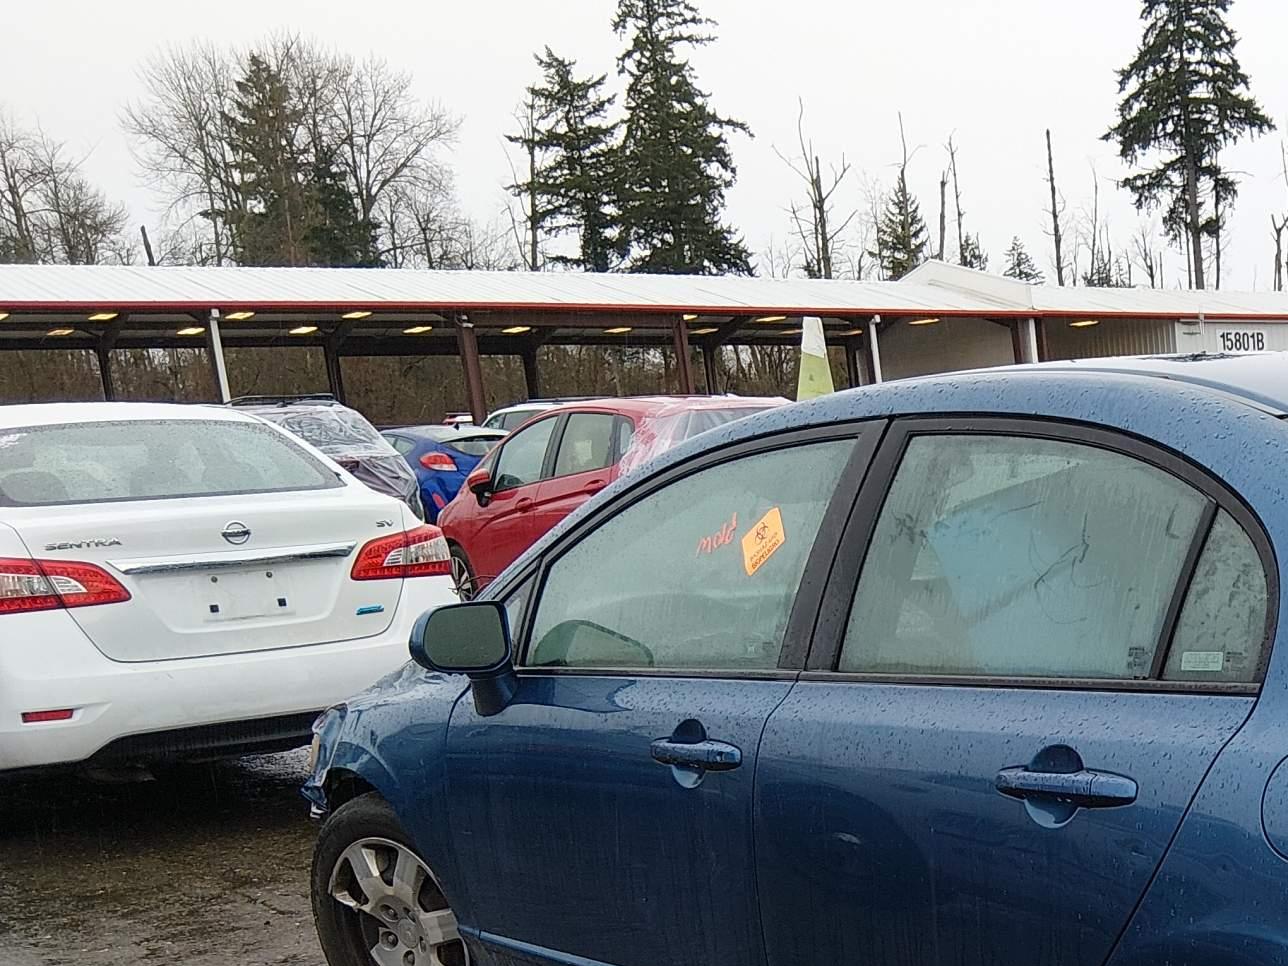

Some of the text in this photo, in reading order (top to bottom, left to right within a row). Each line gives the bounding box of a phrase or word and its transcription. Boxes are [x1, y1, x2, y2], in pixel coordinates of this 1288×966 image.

[1219, 331, 1265, 352] 15801B
[376, 519, 394, 528] SV
[43, 537, 122, 551] SENTRA
